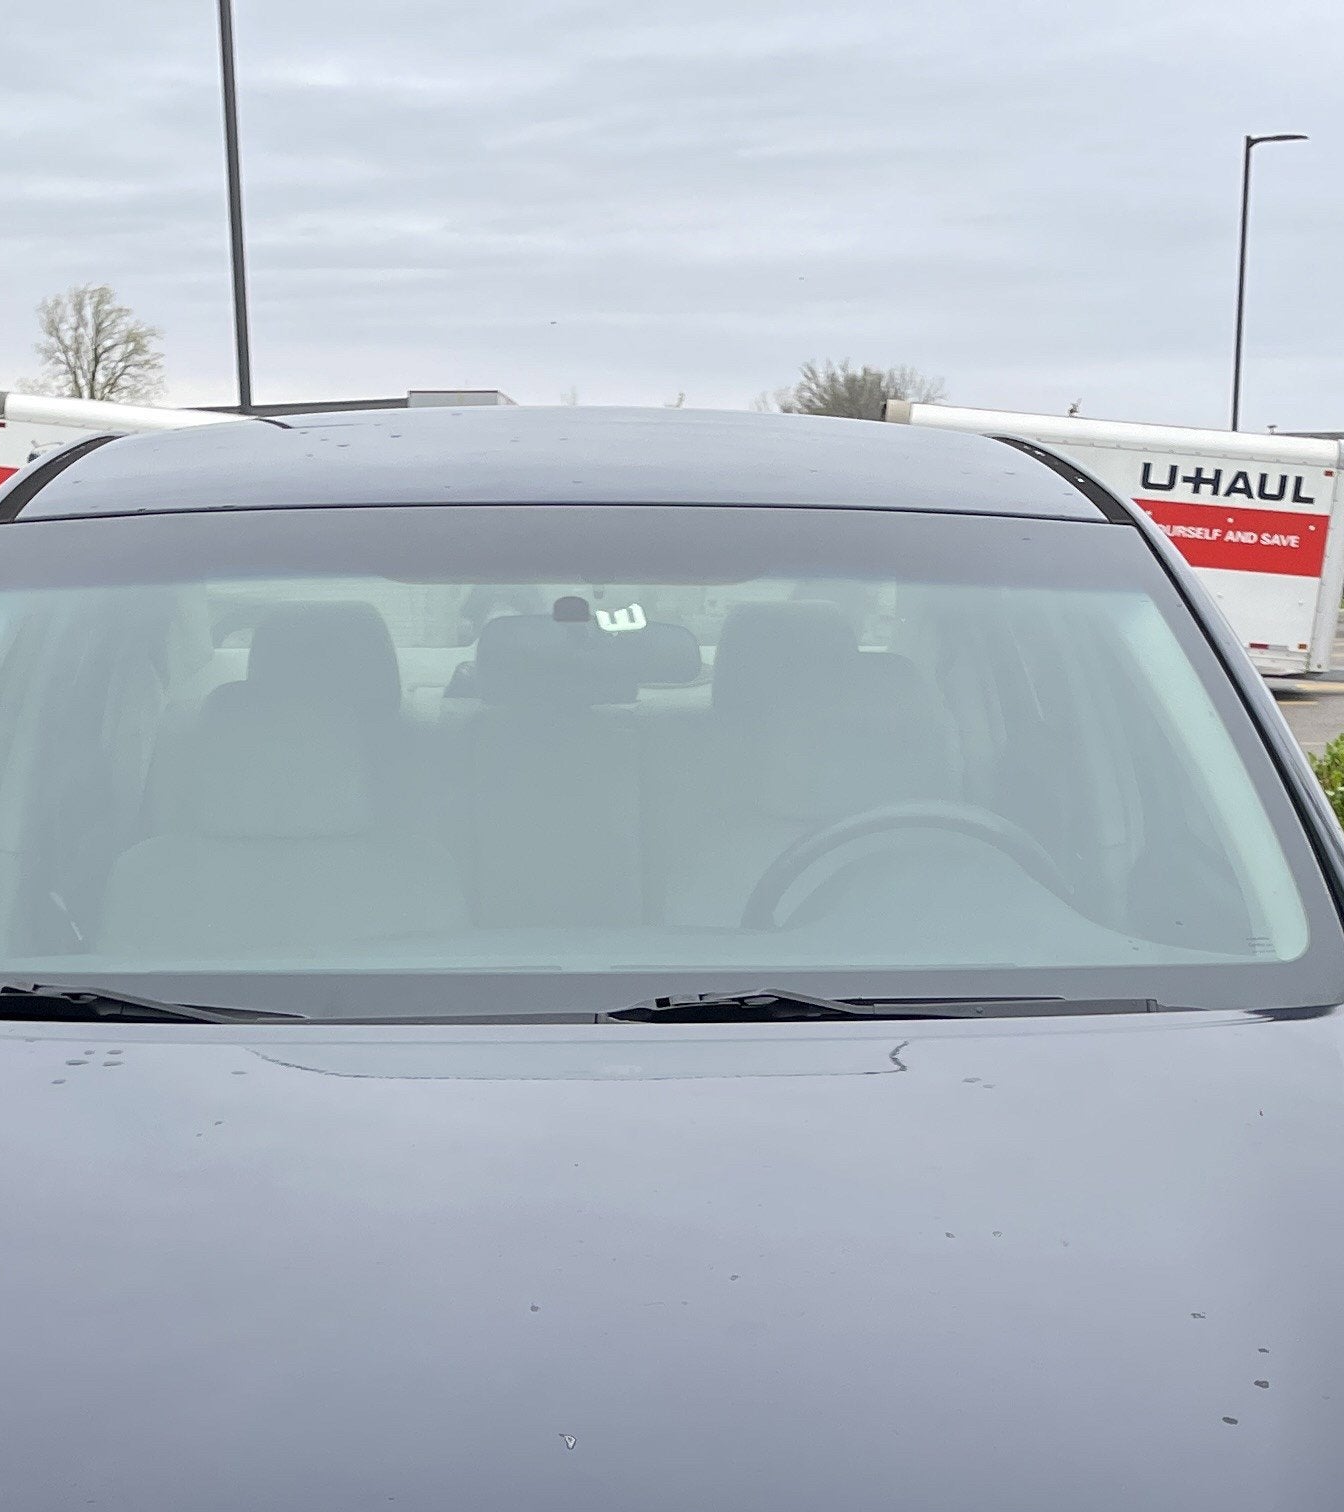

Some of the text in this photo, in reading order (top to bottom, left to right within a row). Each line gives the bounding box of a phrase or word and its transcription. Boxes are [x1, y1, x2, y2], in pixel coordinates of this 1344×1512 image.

[1141, 461, 1315, 504] U-HAUL
[1157, 523, 1301, 549] OURSELF AND SAVE
